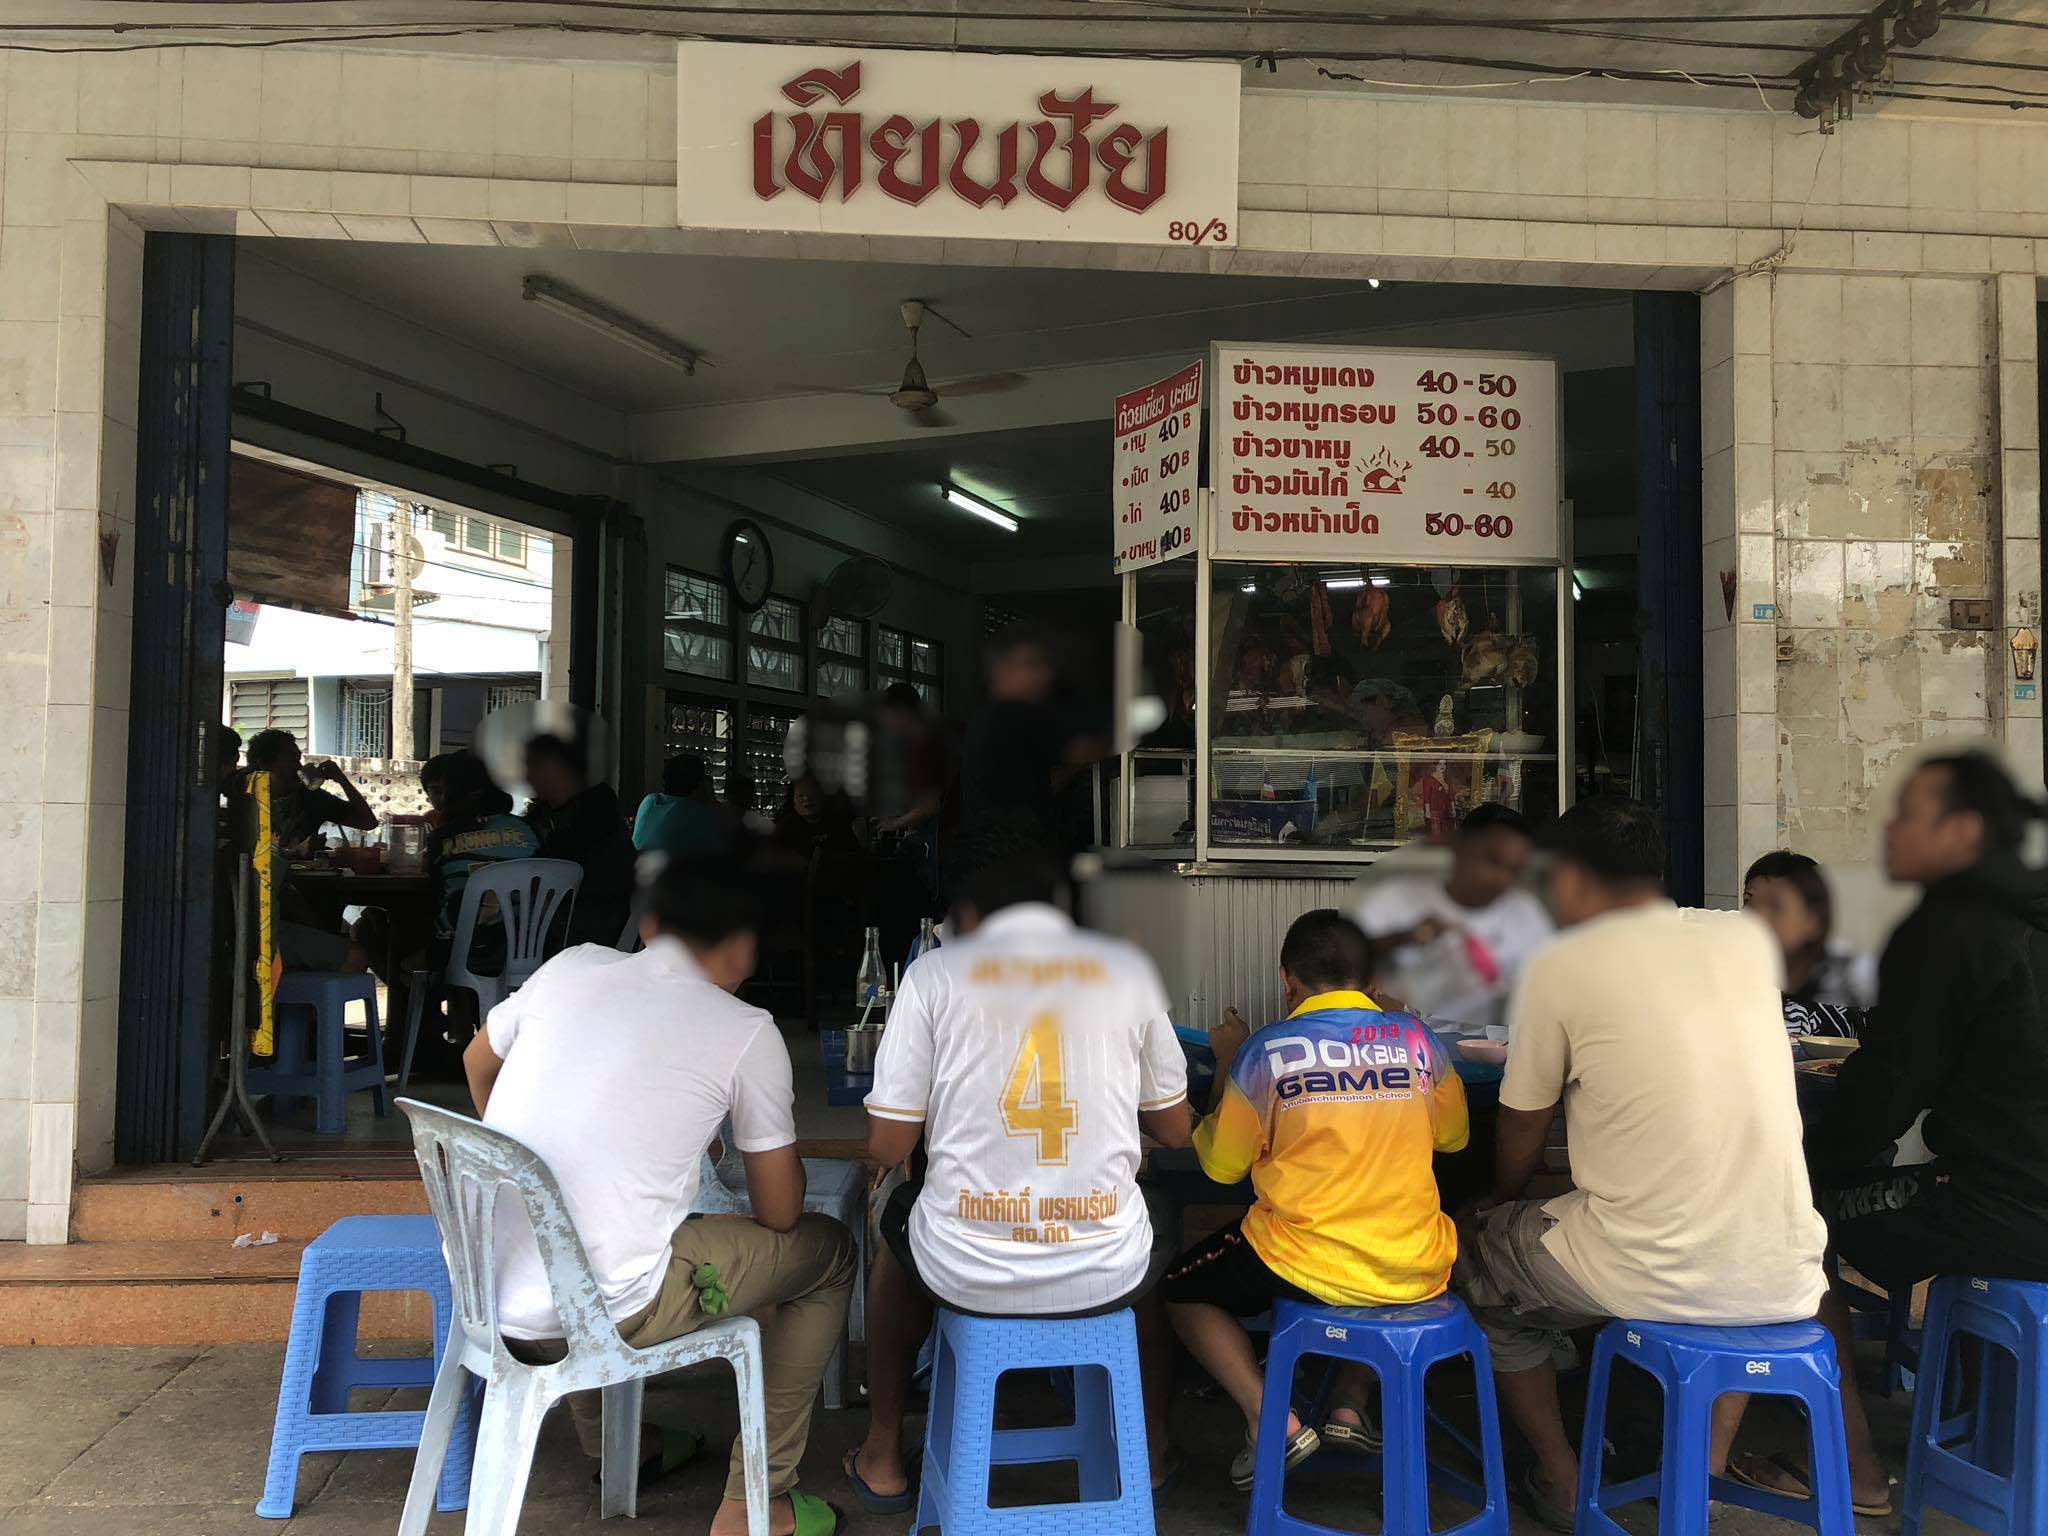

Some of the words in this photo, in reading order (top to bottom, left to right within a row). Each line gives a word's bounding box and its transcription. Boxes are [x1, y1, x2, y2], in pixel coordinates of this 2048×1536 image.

[753, 60, 1168, 214] เทียนชัย
[1168, 217, 1228, 246] 80/3
[1232, 358, 1375, 395] ข้าวหมูแดง
[1232, 394, 1396, 431] ข้าวหมูกรอบ
[1130, 432, 1146, 454] หมู
[1158, 415, 1179, 443] 40
[1232, 431, 1351, 468] ข้าวขาหมู
[1131, 465, 1149, 488] เป็ด
[1160, 452, 1180, 479] 50
[1232, 466, 1348, 497] ข้าวมันไก่
[1128, 502, 1142, 524] ไก่
[1160, 490, 1180, 515] 40
[1231, 501, 1379, 534] ข้าวหน้าเป็ด
[1350, 1023, 1400, 1044] 2019
[998, 1008, 1080, 1167] 4
[1377, 1091, 1412, 1100] School
[1971, 1277, 1989, 1292] est
[1325, 1325, 1348, 1341] est
[1626, 1330, 1642, 1346] est
[1745, 1360, 1771, 1374] est
[1327, 1427, 1348, 1435] crocs
